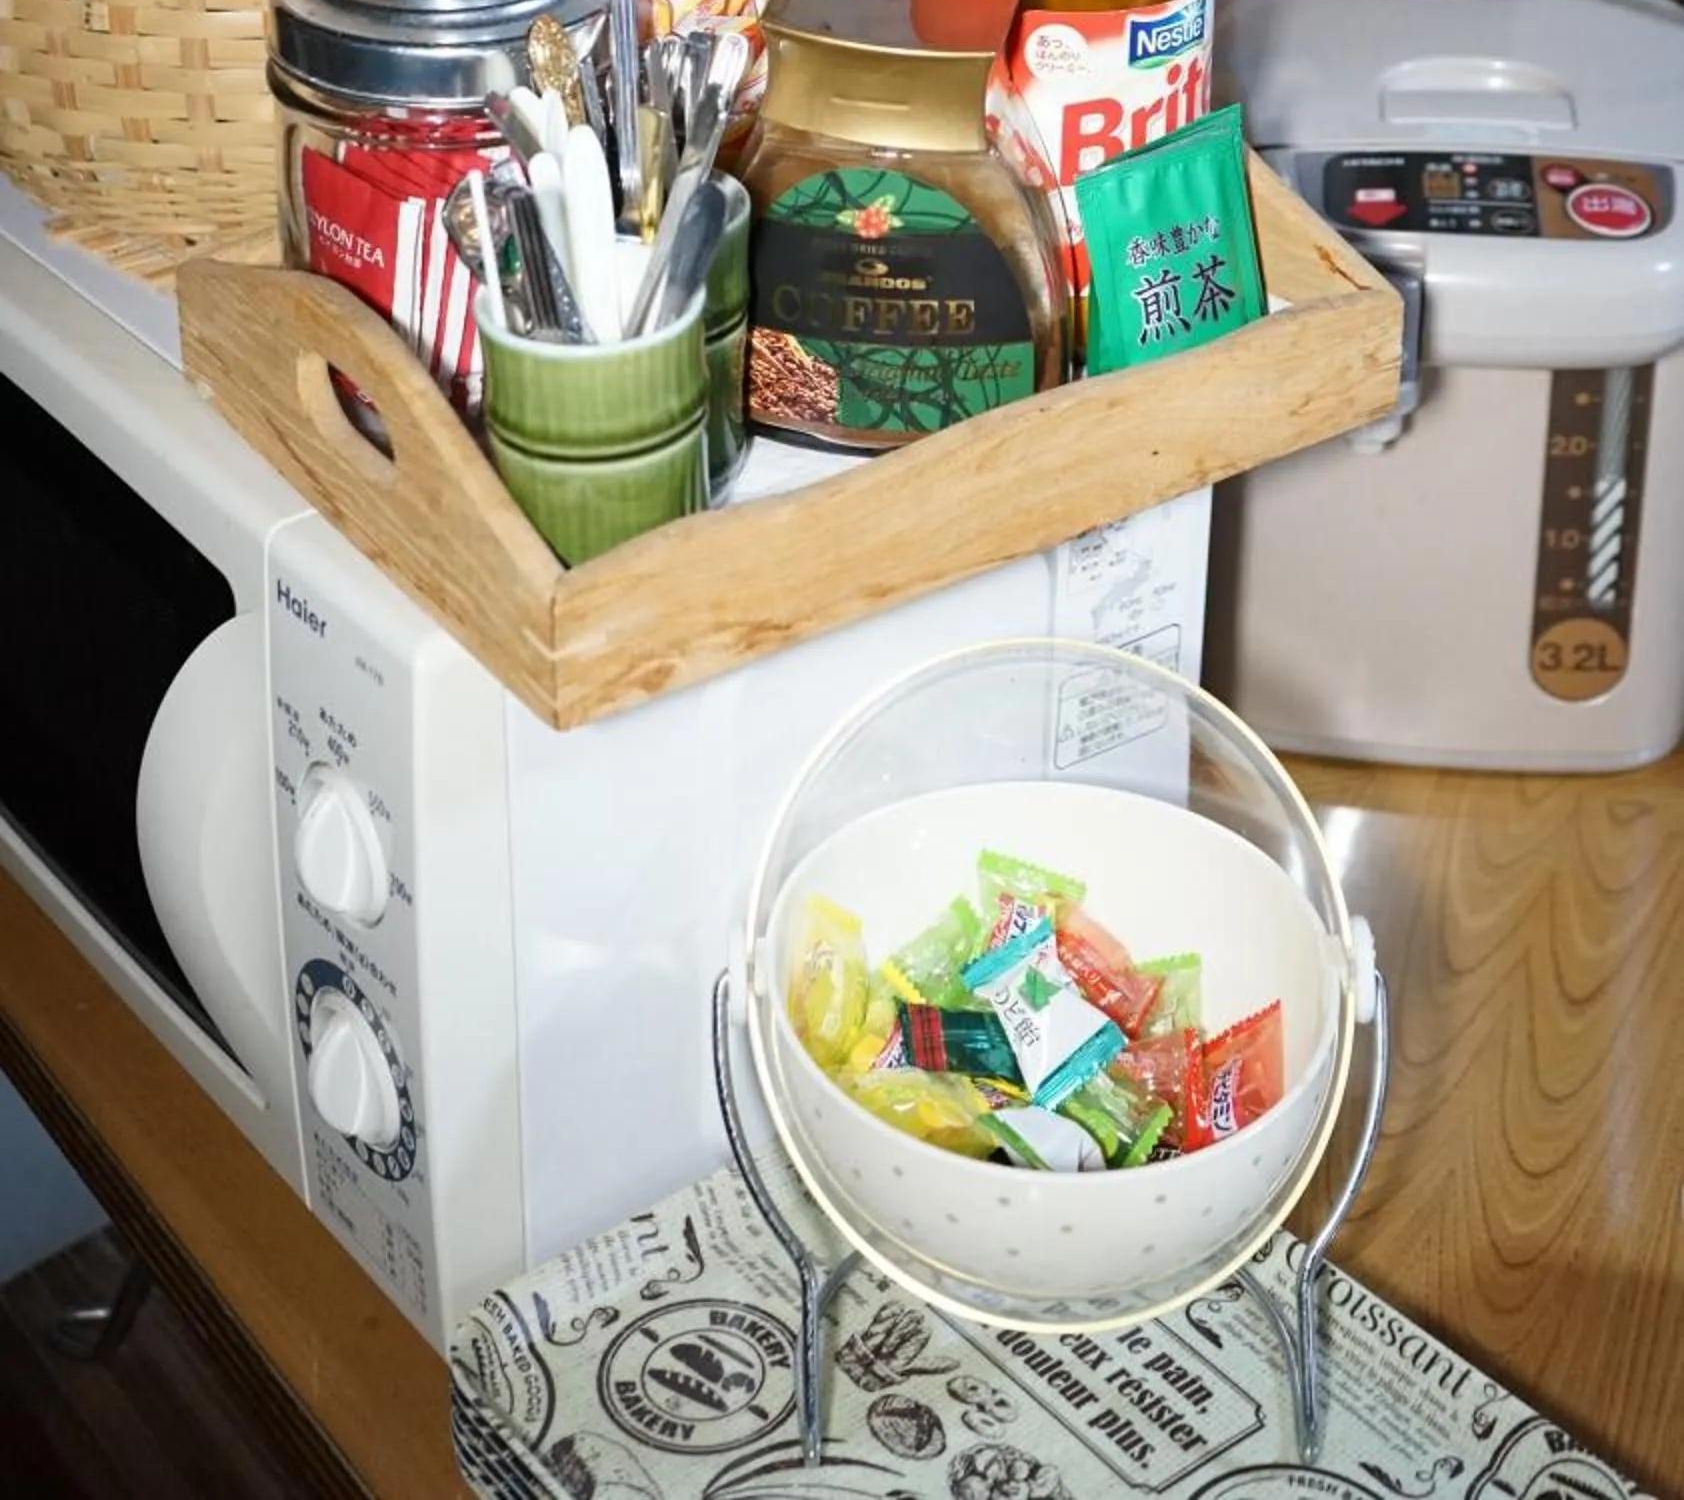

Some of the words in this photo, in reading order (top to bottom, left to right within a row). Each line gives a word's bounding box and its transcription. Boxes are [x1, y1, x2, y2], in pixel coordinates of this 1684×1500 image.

[1059, 58, 1211, 186] Brit
[356, 236, 385, 269] TEA
[1127, 214, 1221, 267] 香味豊かな
[772, 284, 976, 336] COFFEE
[1133, 255, 1237, 346] 煎茶
[276, 579, 328, 638] Haier
[502, 1323, 533, 1374] BAKED
[708, 1308, 792, 1371] BAKERY
[1115, 1326, 1152, 1355] le
[1142, 1352, 1215, 1415] pain,
[615, 1380, 698, 1443] BAKERY
[1087, 1407, 1157, 1469] plus.
[1105, 1366, 1209, 1452] résister
